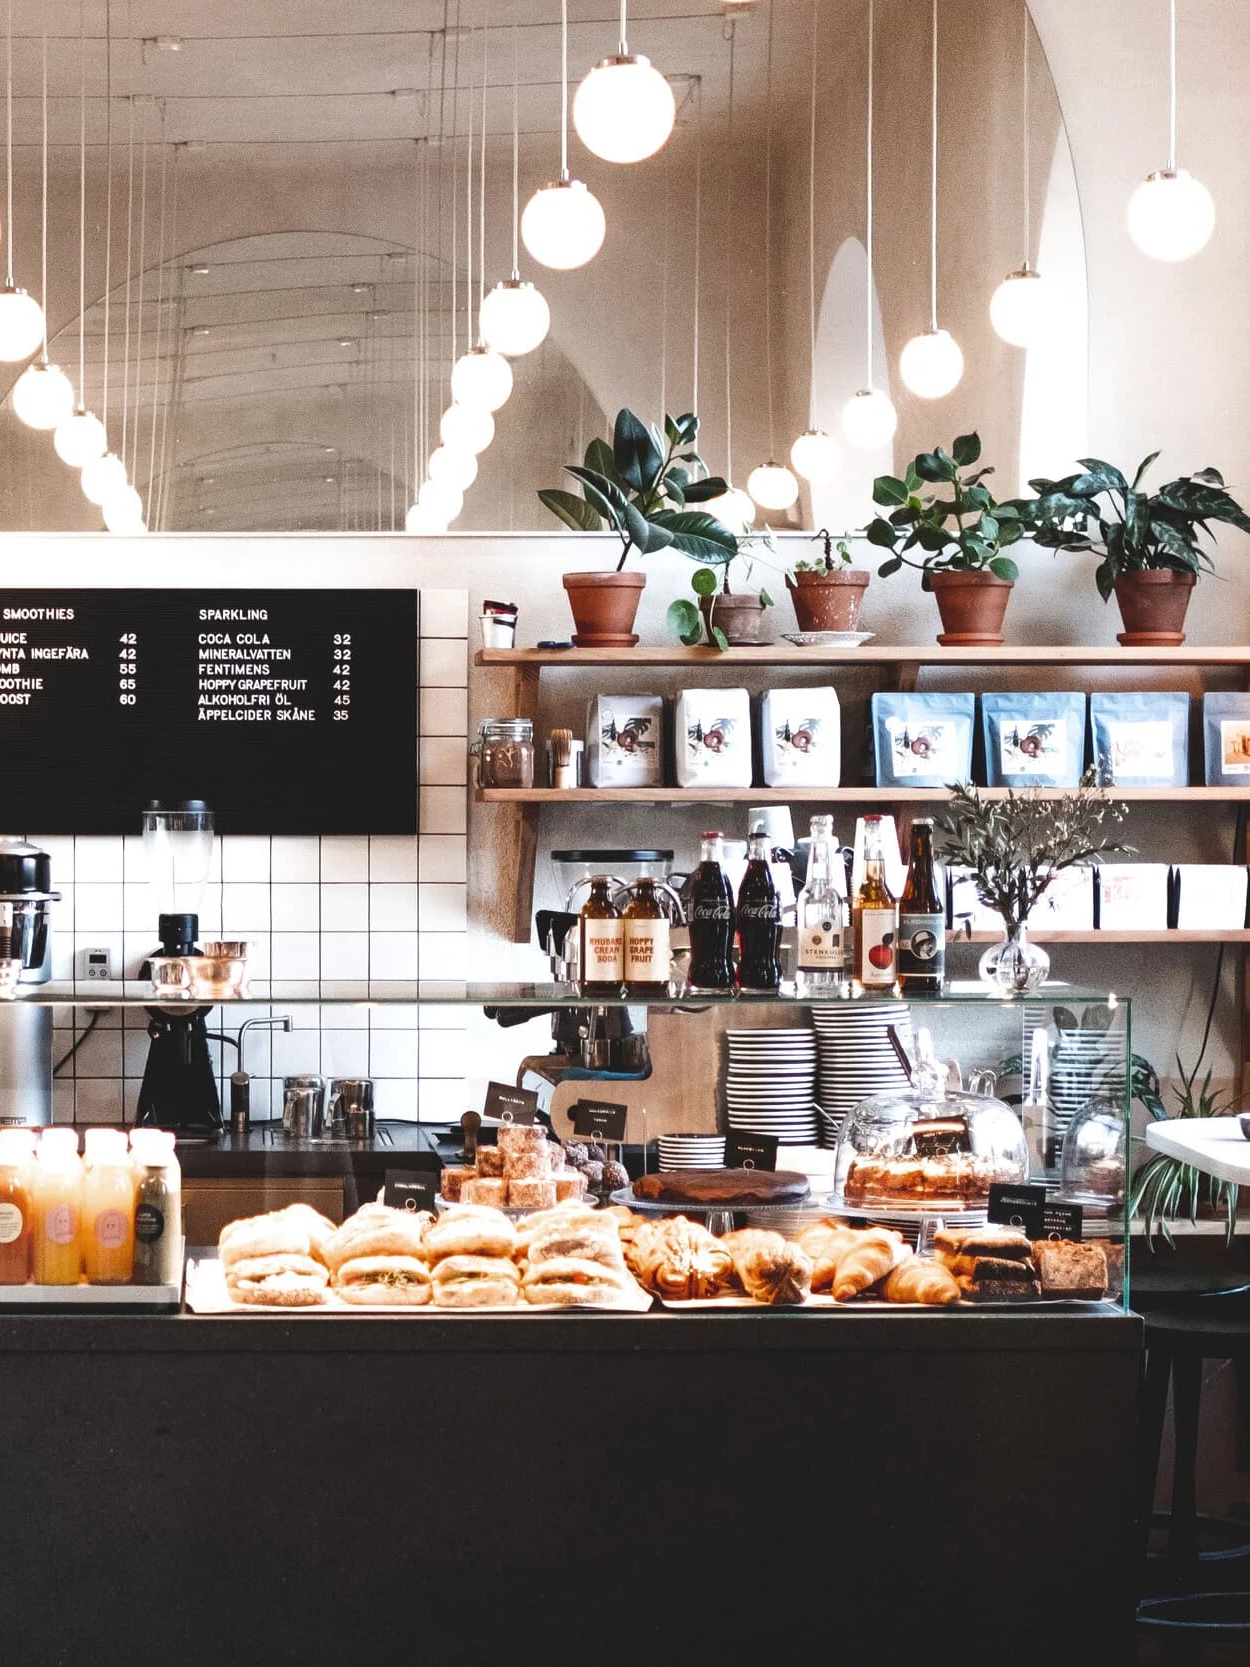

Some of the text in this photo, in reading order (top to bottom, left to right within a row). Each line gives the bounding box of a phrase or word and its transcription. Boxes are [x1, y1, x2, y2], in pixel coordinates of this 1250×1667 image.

[3, 608, 74, 620] SMOOTHIES
[199, 609, 268, 620] SPARKLING
[119, 633, 137, 644] 42
[198, 634, 351, 645] COCA COLA 32
[31, 646, 89, 659] INGEFÄRA
[119, 648, 137, 659] 42
[198, 649, 351, 660] MINERALVATTEN 32
[119, 663, 137, 674] 55
[198, 664, 351, 675] FENTIMENS 42
[119, 678, 137, 690] 65
[199, 679, 351, 690] HOPPY GRAPEFRUIT 42
[119, 694, 137, 705] 60
[198, 693, 351, 705] ALKOHOLFRI ÖL 45
[198, 707, 349, 720] ÄPPELCIDER SKÅNE 35
[629, 937, 654, 945] HOPPY
[594, 946, 620, 954] CREAM
[629, 946, 654, 954] GRAPE
[597, 955, 617, 963] SODA
[631, 955, 653, 963] FRUIT
